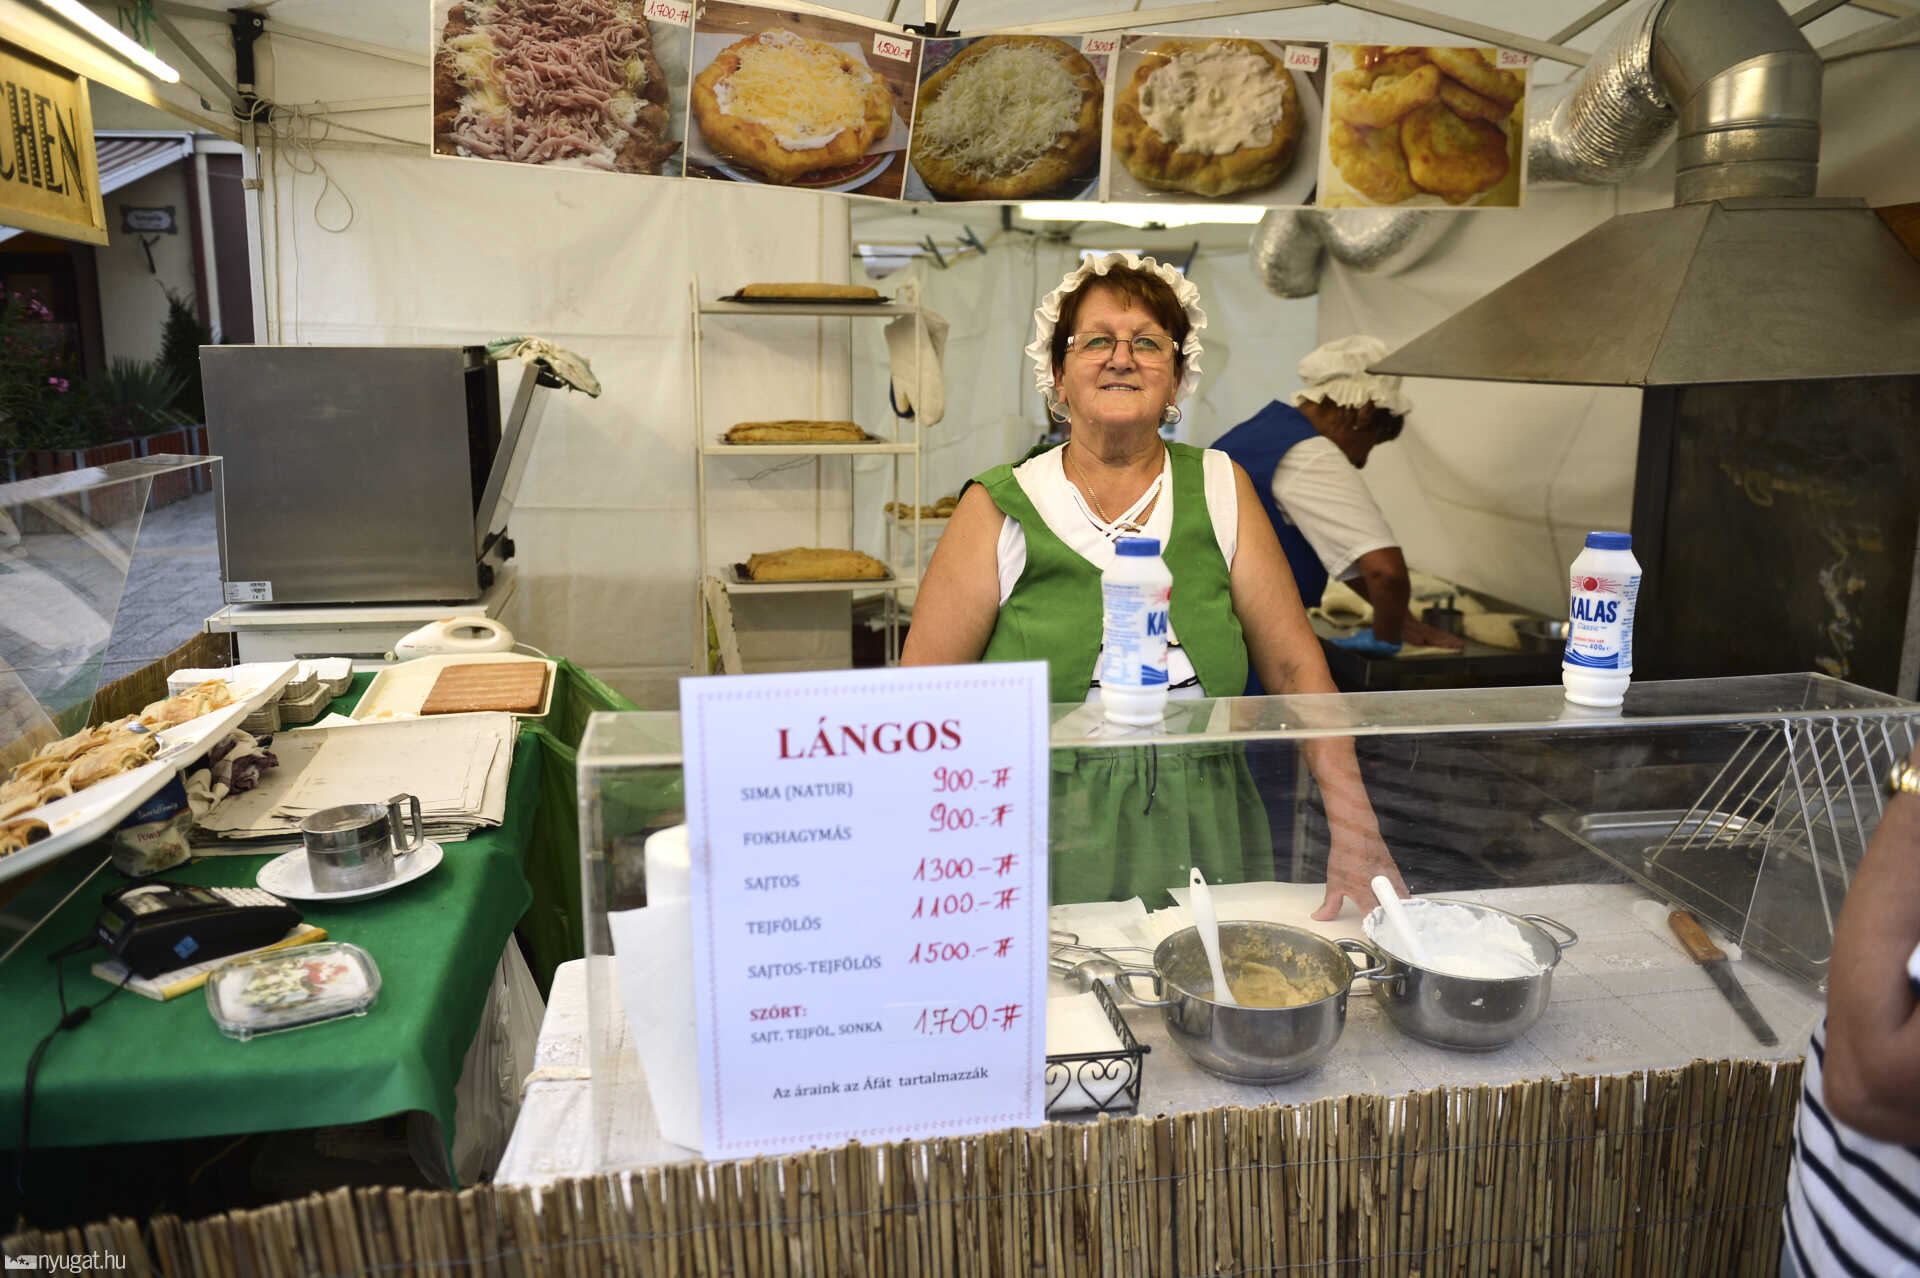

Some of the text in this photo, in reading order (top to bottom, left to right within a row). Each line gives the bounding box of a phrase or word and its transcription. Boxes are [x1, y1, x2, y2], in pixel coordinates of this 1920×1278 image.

[1571, 595, 1618, 624] KALAS
[778, 716, 962, 760] LÁNGOS
[741, 782, 853, 802] SIMA (NATUR)
[743, 825, 852, 846] FOKHAGYMÁS
[744, 874, 800, 892] SAJTOS
[746, 916, 822, 936] TEJFÖLÖS
[748, 955, 882, 980] SAJTOS-TEJFÖLÖS
[749, 1004, 807, 1021] SZÓRT:
[838, 1020, 883, 1036] SONKA
[772, 1066, 989, 1100] Az áraink az Áfát tartalmazzák
